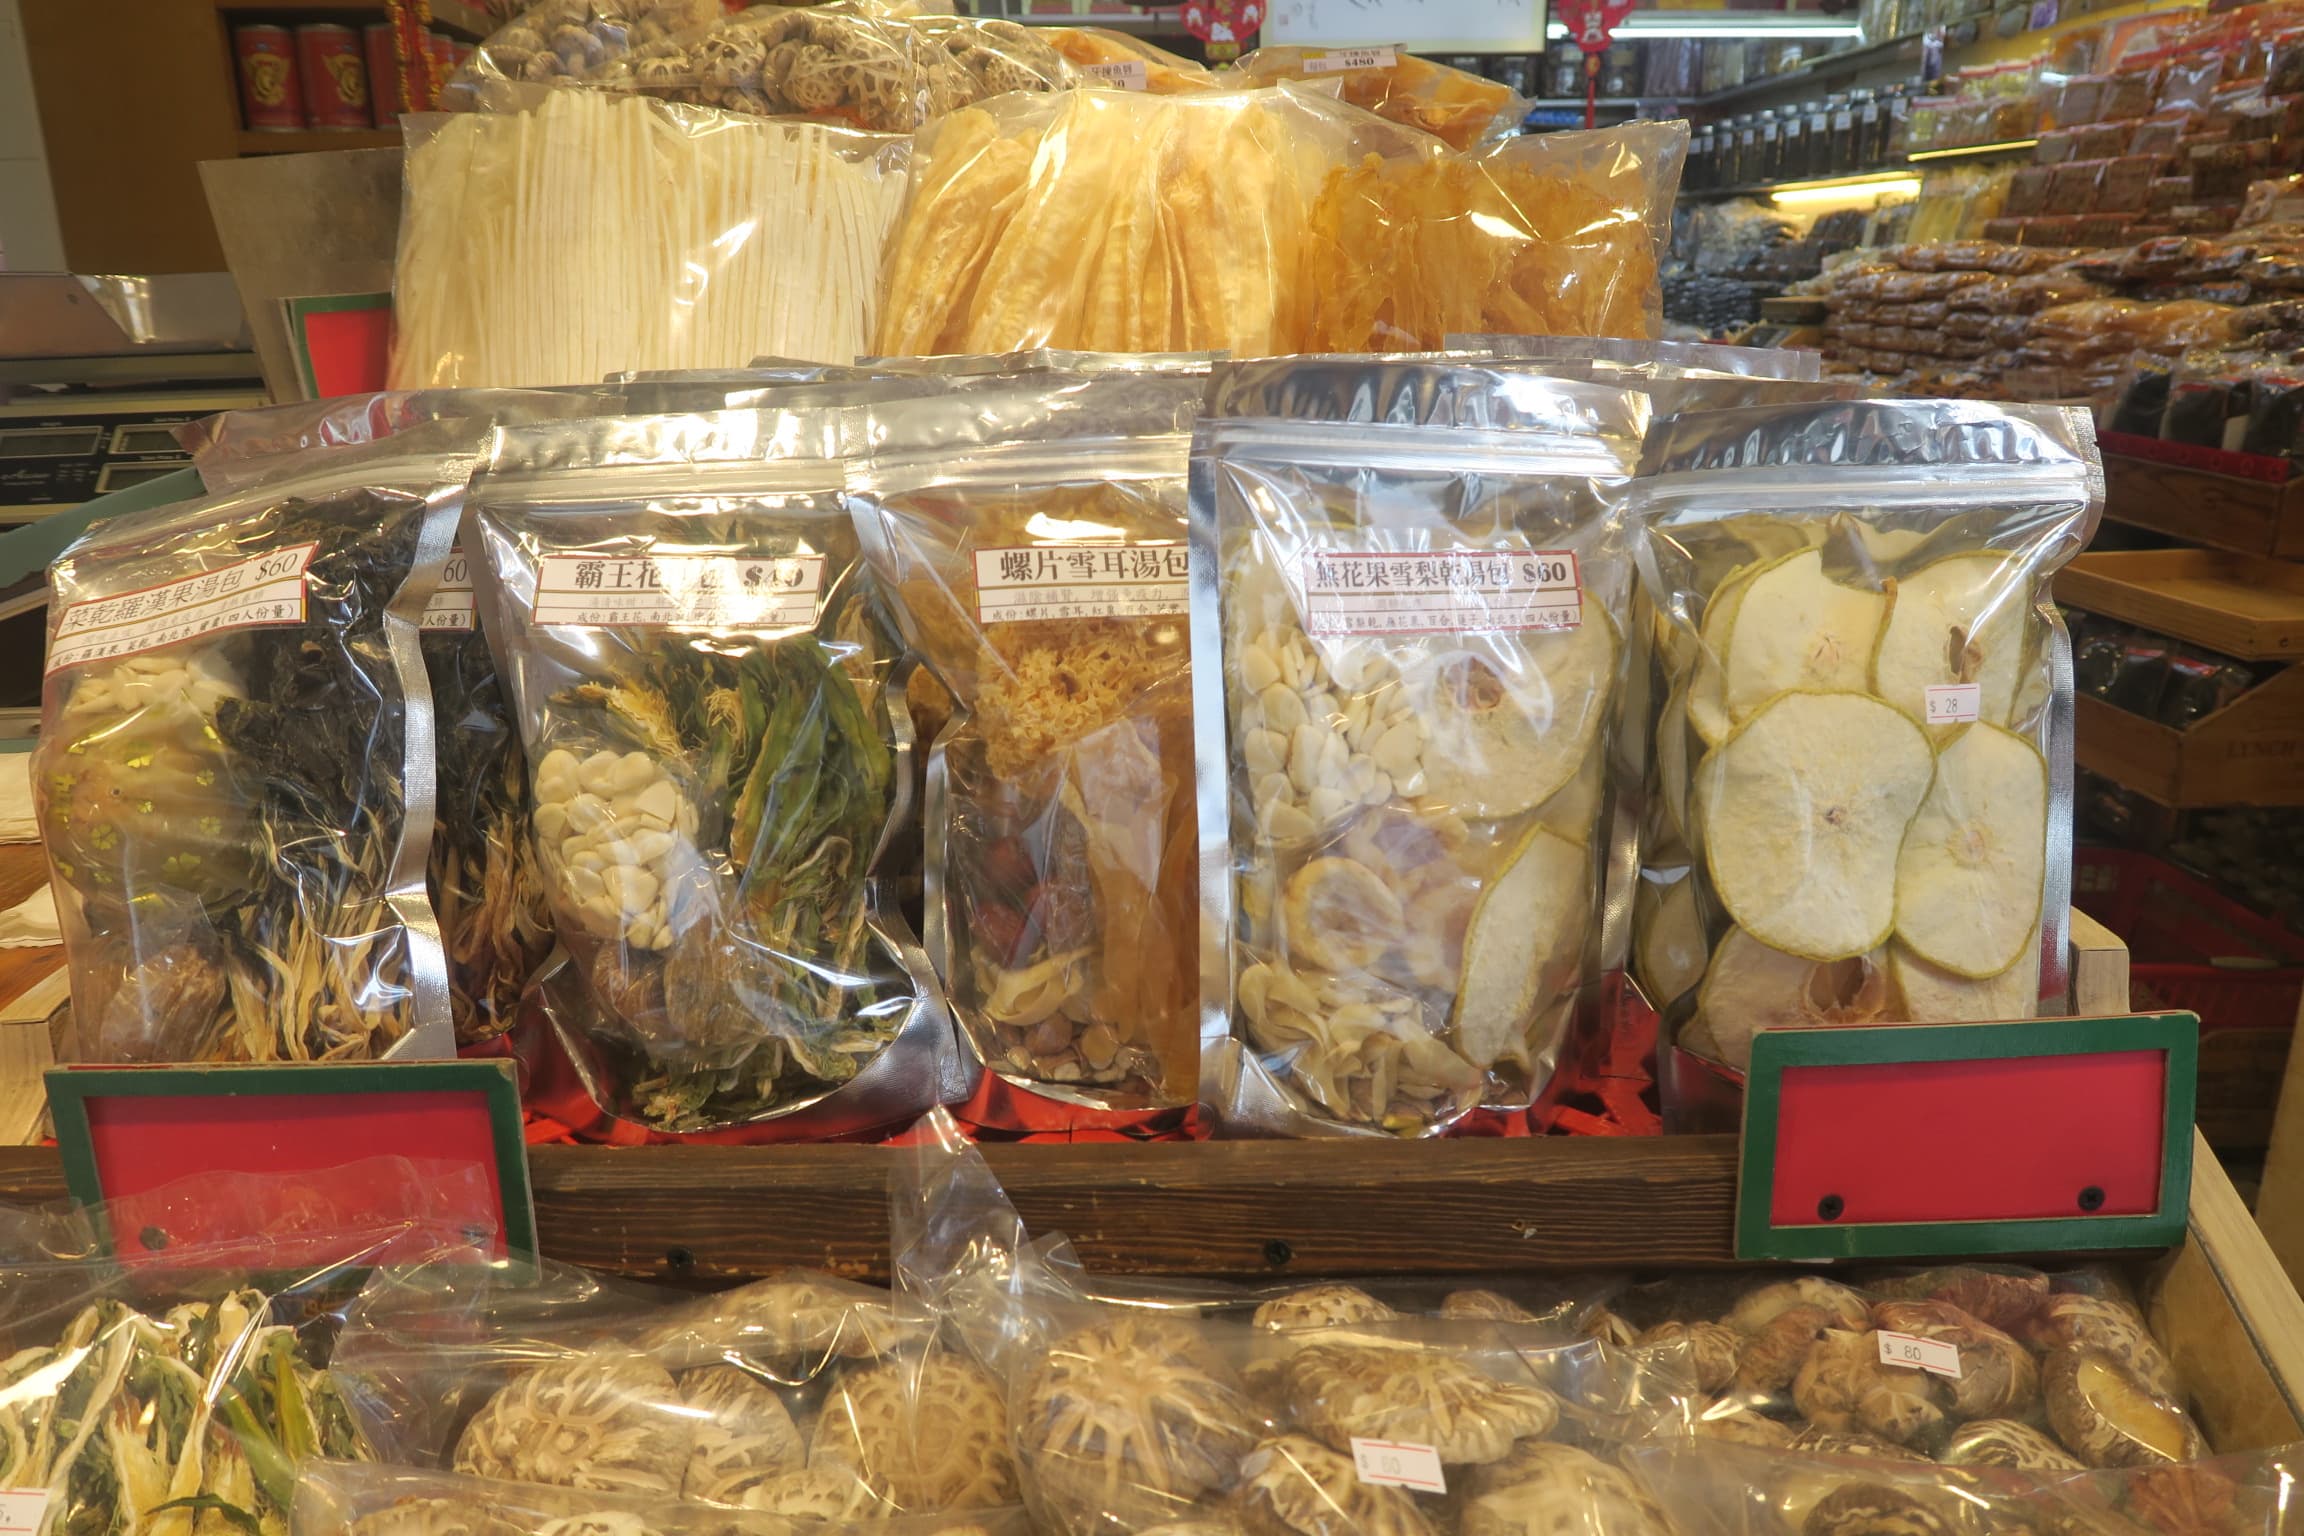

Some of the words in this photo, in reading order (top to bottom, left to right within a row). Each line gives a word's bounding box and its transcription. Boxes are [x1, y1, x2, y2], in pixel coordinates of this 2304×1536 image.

[254, 553, 298, 583] $60
[1000, 549, 1189, 582] 螺片雪耳湯包
[1522, 562, 1567, 583] $60
[1945, 697, 1958, 714] 28
[1904, 1345, 1922, 1361] 80
